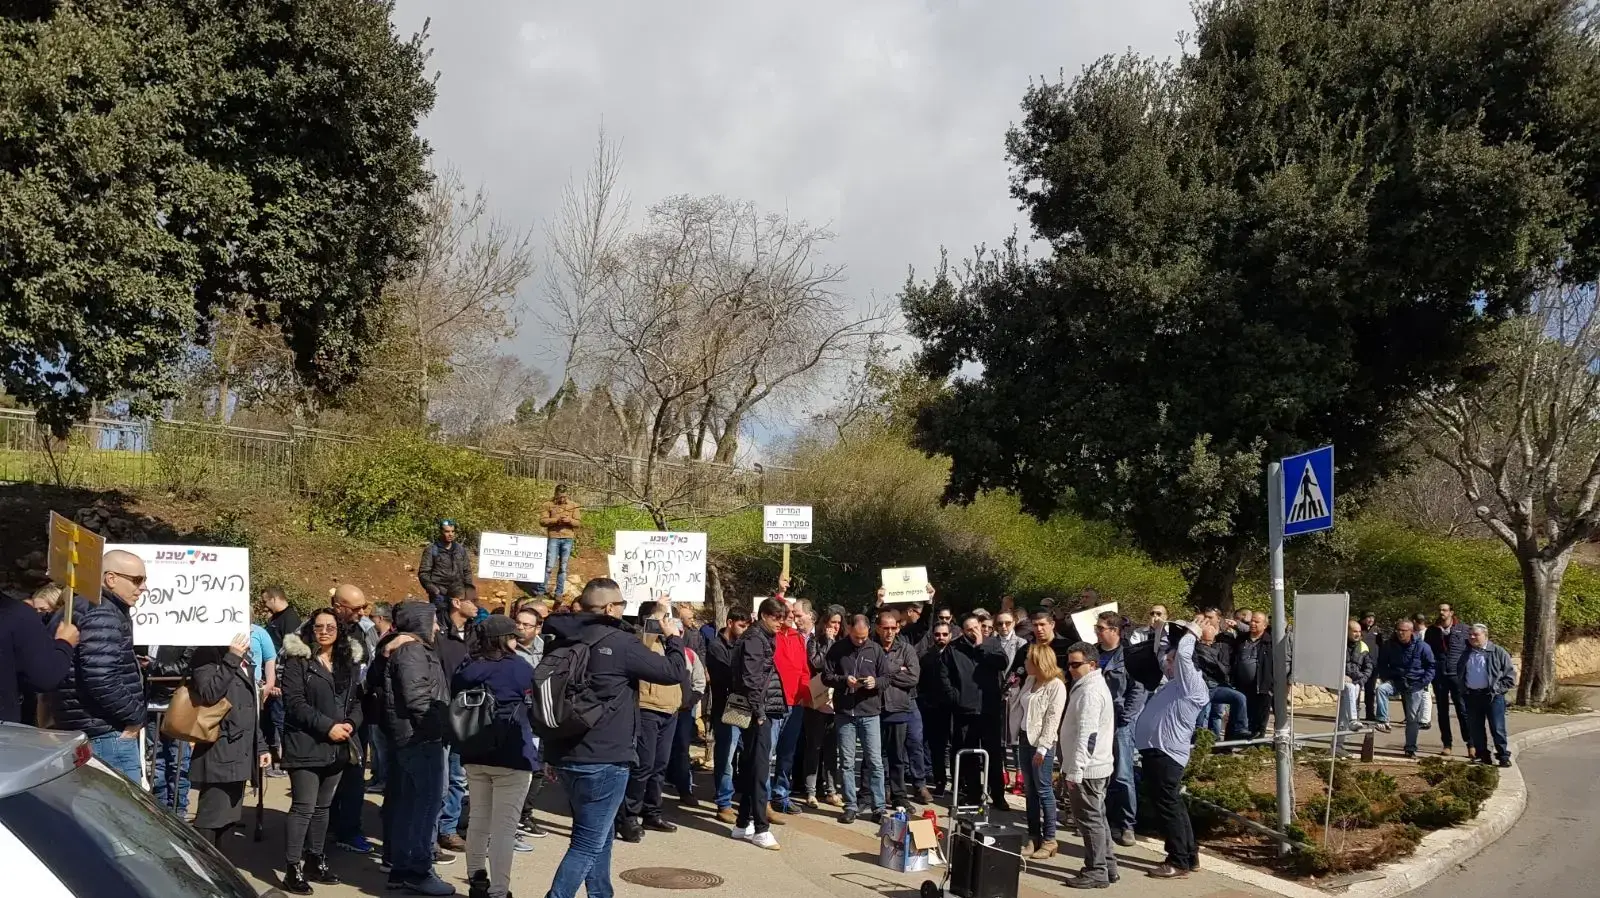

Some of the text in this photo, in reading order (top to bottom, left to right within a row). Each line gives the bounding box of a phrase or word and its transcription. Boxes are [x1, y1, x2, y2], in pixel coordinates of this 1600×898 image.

[156, 551, 186, 560] שבע
[174, 574, 245, 595] המדינה
[165, 605, 209, 624] שומרי
[214, 606, 244, 624] את
